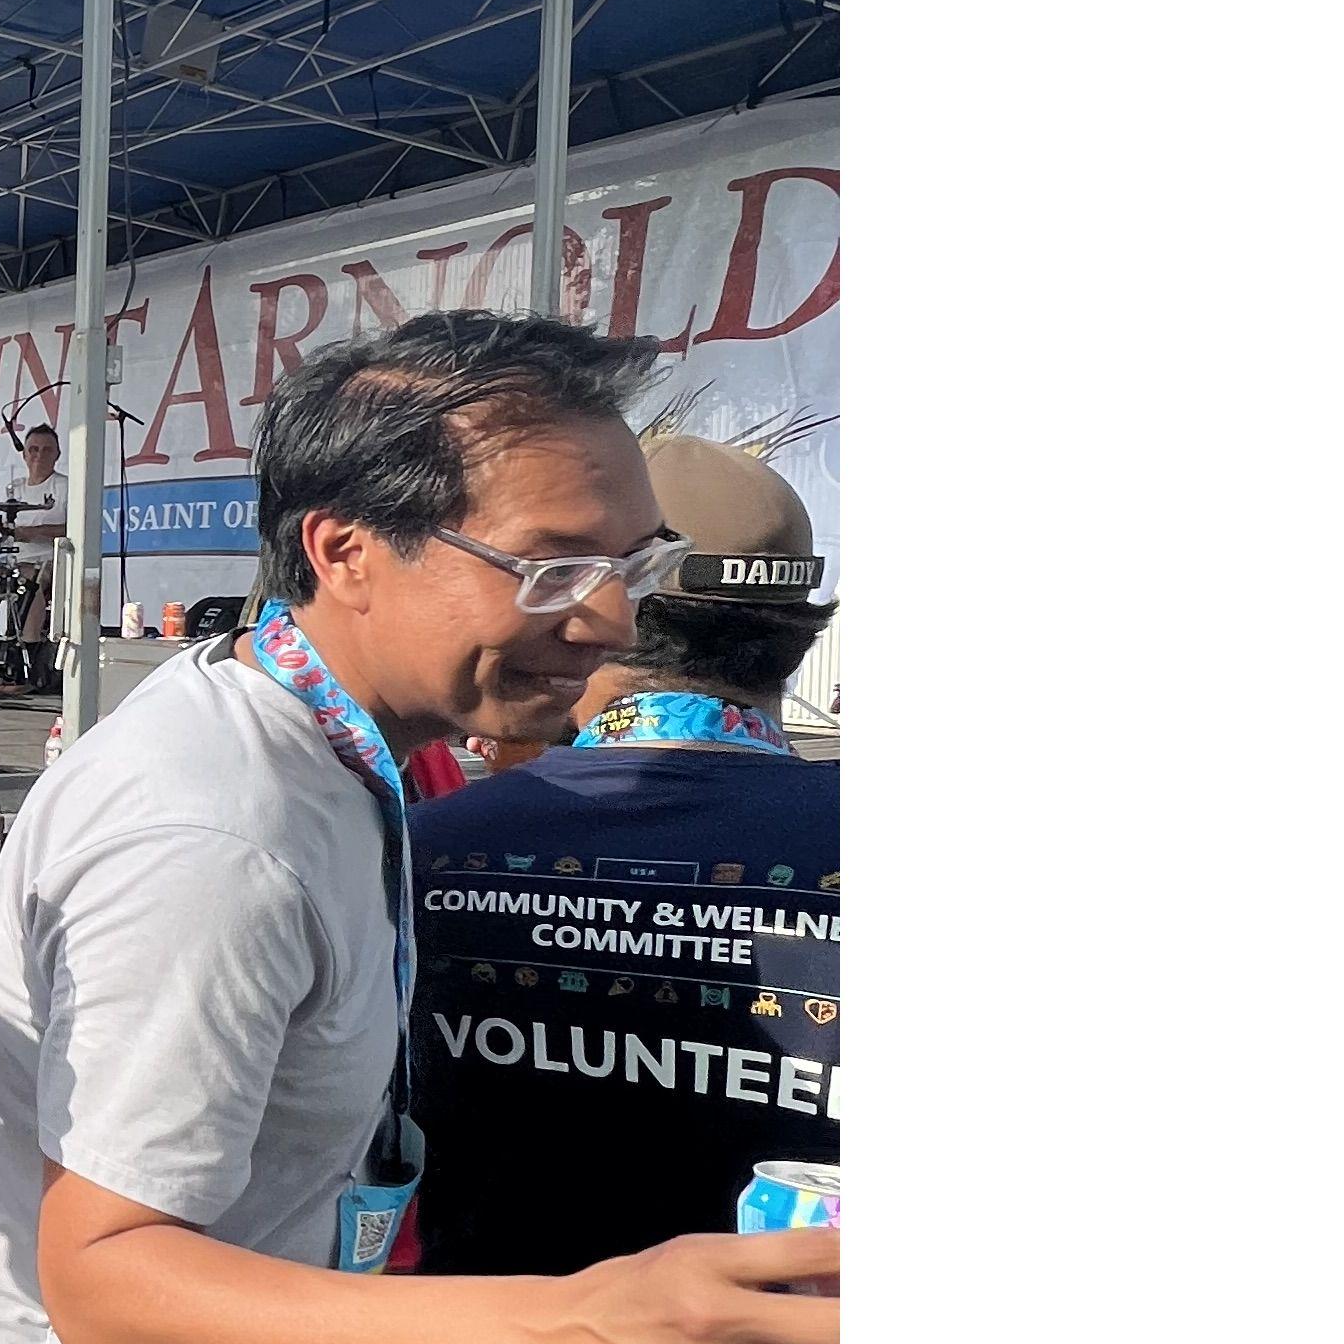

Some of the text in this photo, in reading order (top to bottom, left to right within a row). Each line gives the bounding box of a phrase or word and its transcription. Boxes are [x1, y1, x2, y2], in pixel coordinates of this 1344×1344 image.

[124, 500, 218, 532] SAINT
[720, 559, 815, 584] DADDY
[424, 889, 641, 926] COMMUNITY
[653, 900, 685, 928] &
[531, 923, 753, 966] COMMITTEE
